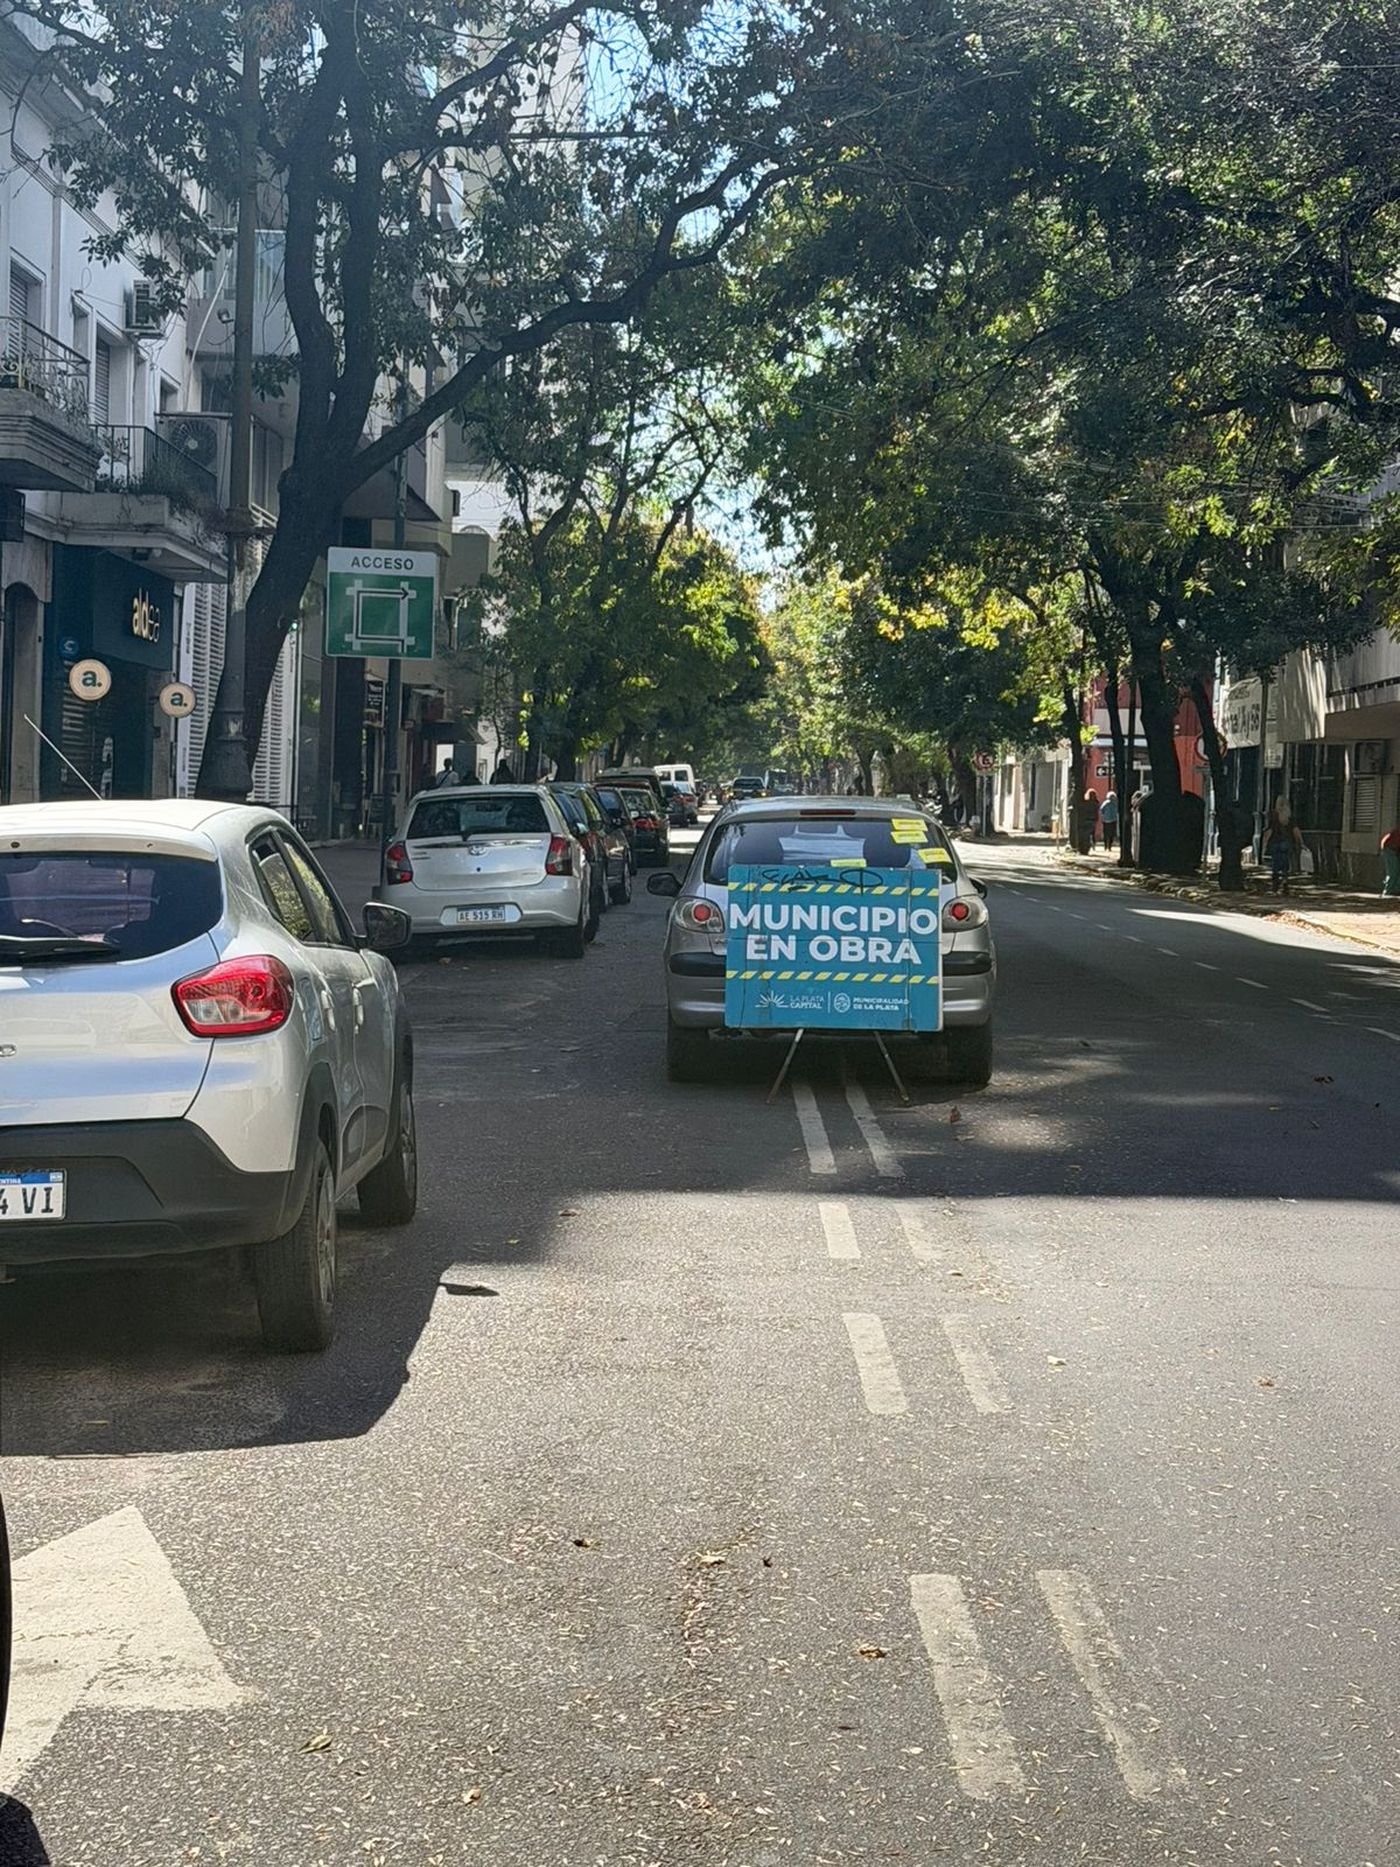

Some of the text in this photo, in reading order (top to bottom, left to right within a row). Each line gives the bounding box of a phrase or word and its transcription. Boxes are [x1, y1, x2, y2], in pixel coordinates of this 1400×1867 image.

[351, 556, 414, 571] ACCESO
[729, 903, 938, 935] MUNICIPIO
[746, 934, 922, 965] EN OBRA
[22, 1187, 54, 1214] VI
